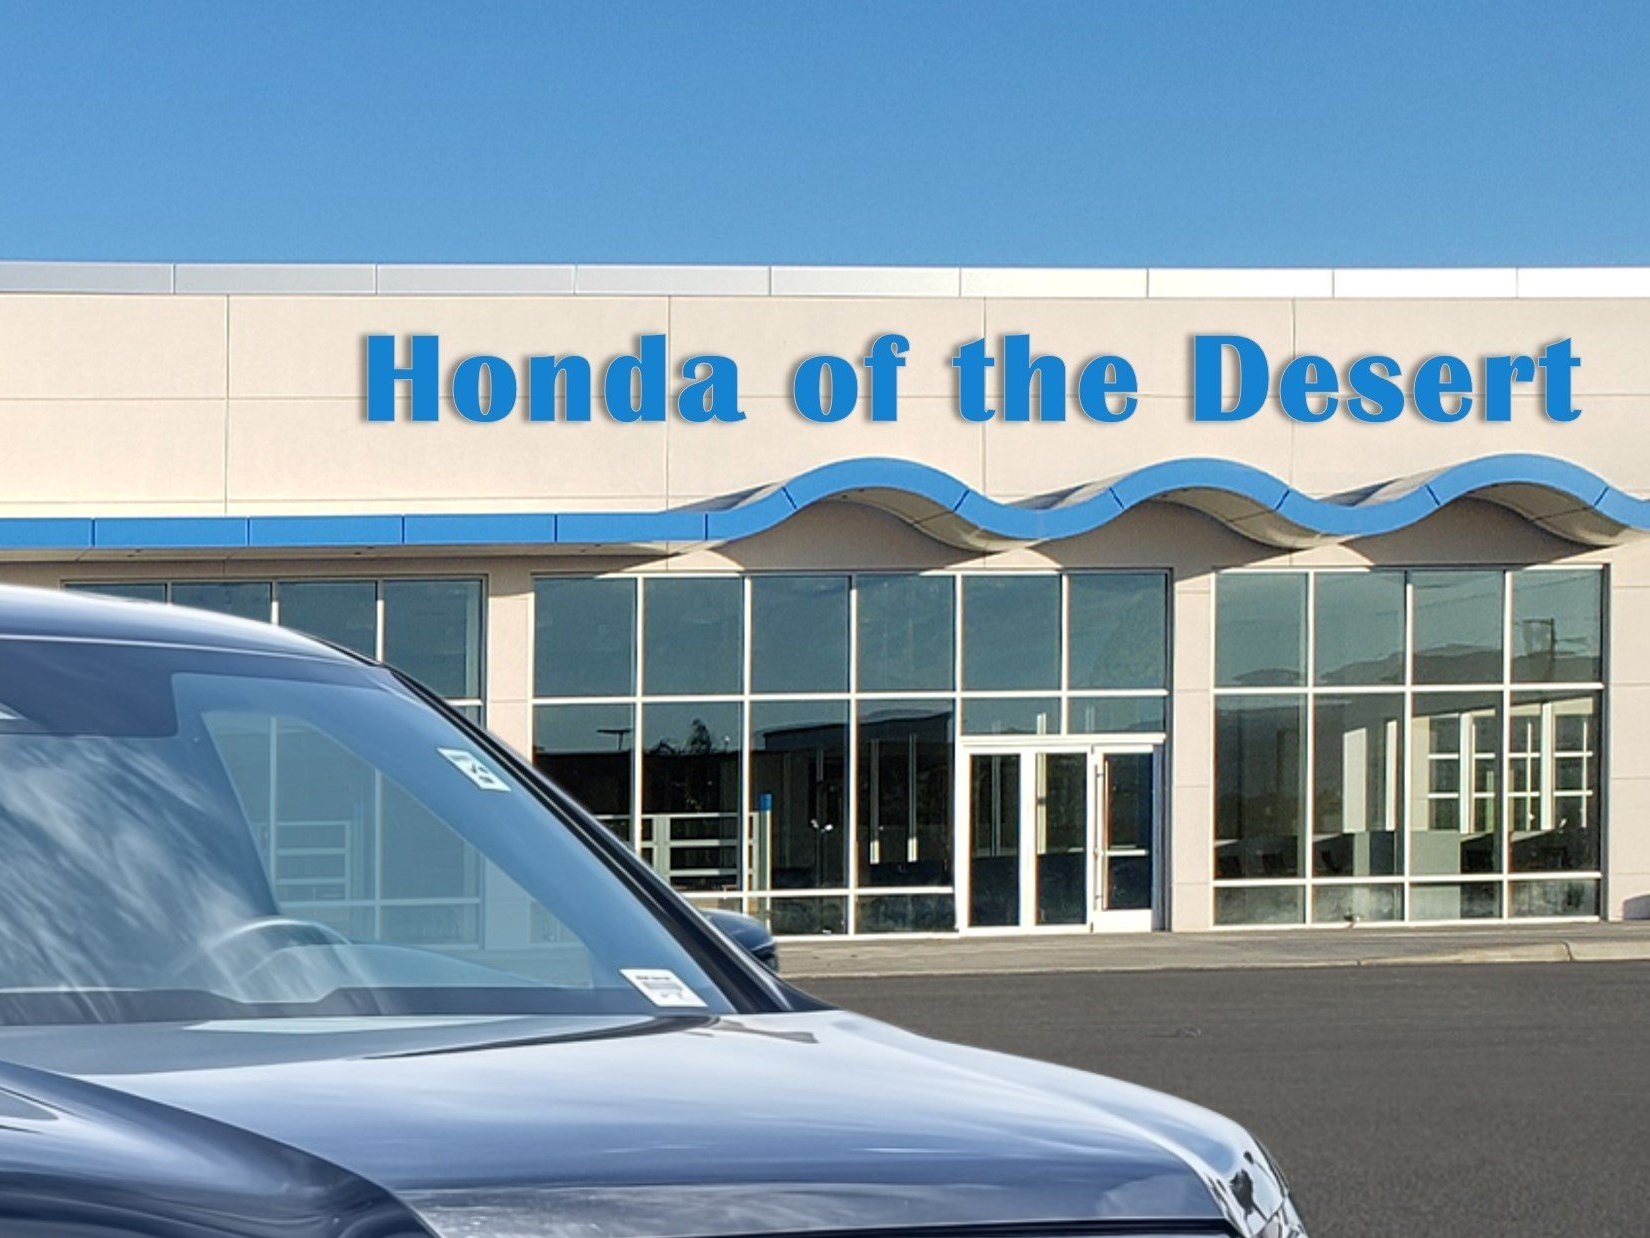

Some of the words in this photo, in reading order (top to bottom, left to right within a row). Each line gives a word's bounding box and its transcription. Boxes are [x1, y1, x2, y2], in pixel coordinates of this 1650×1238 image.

[365, 333, 747, 424] Honda
[793, 333, 910, 424] of
[951, 333, 1138, 424] the
[1194, 334, 1583, 424] Desert
